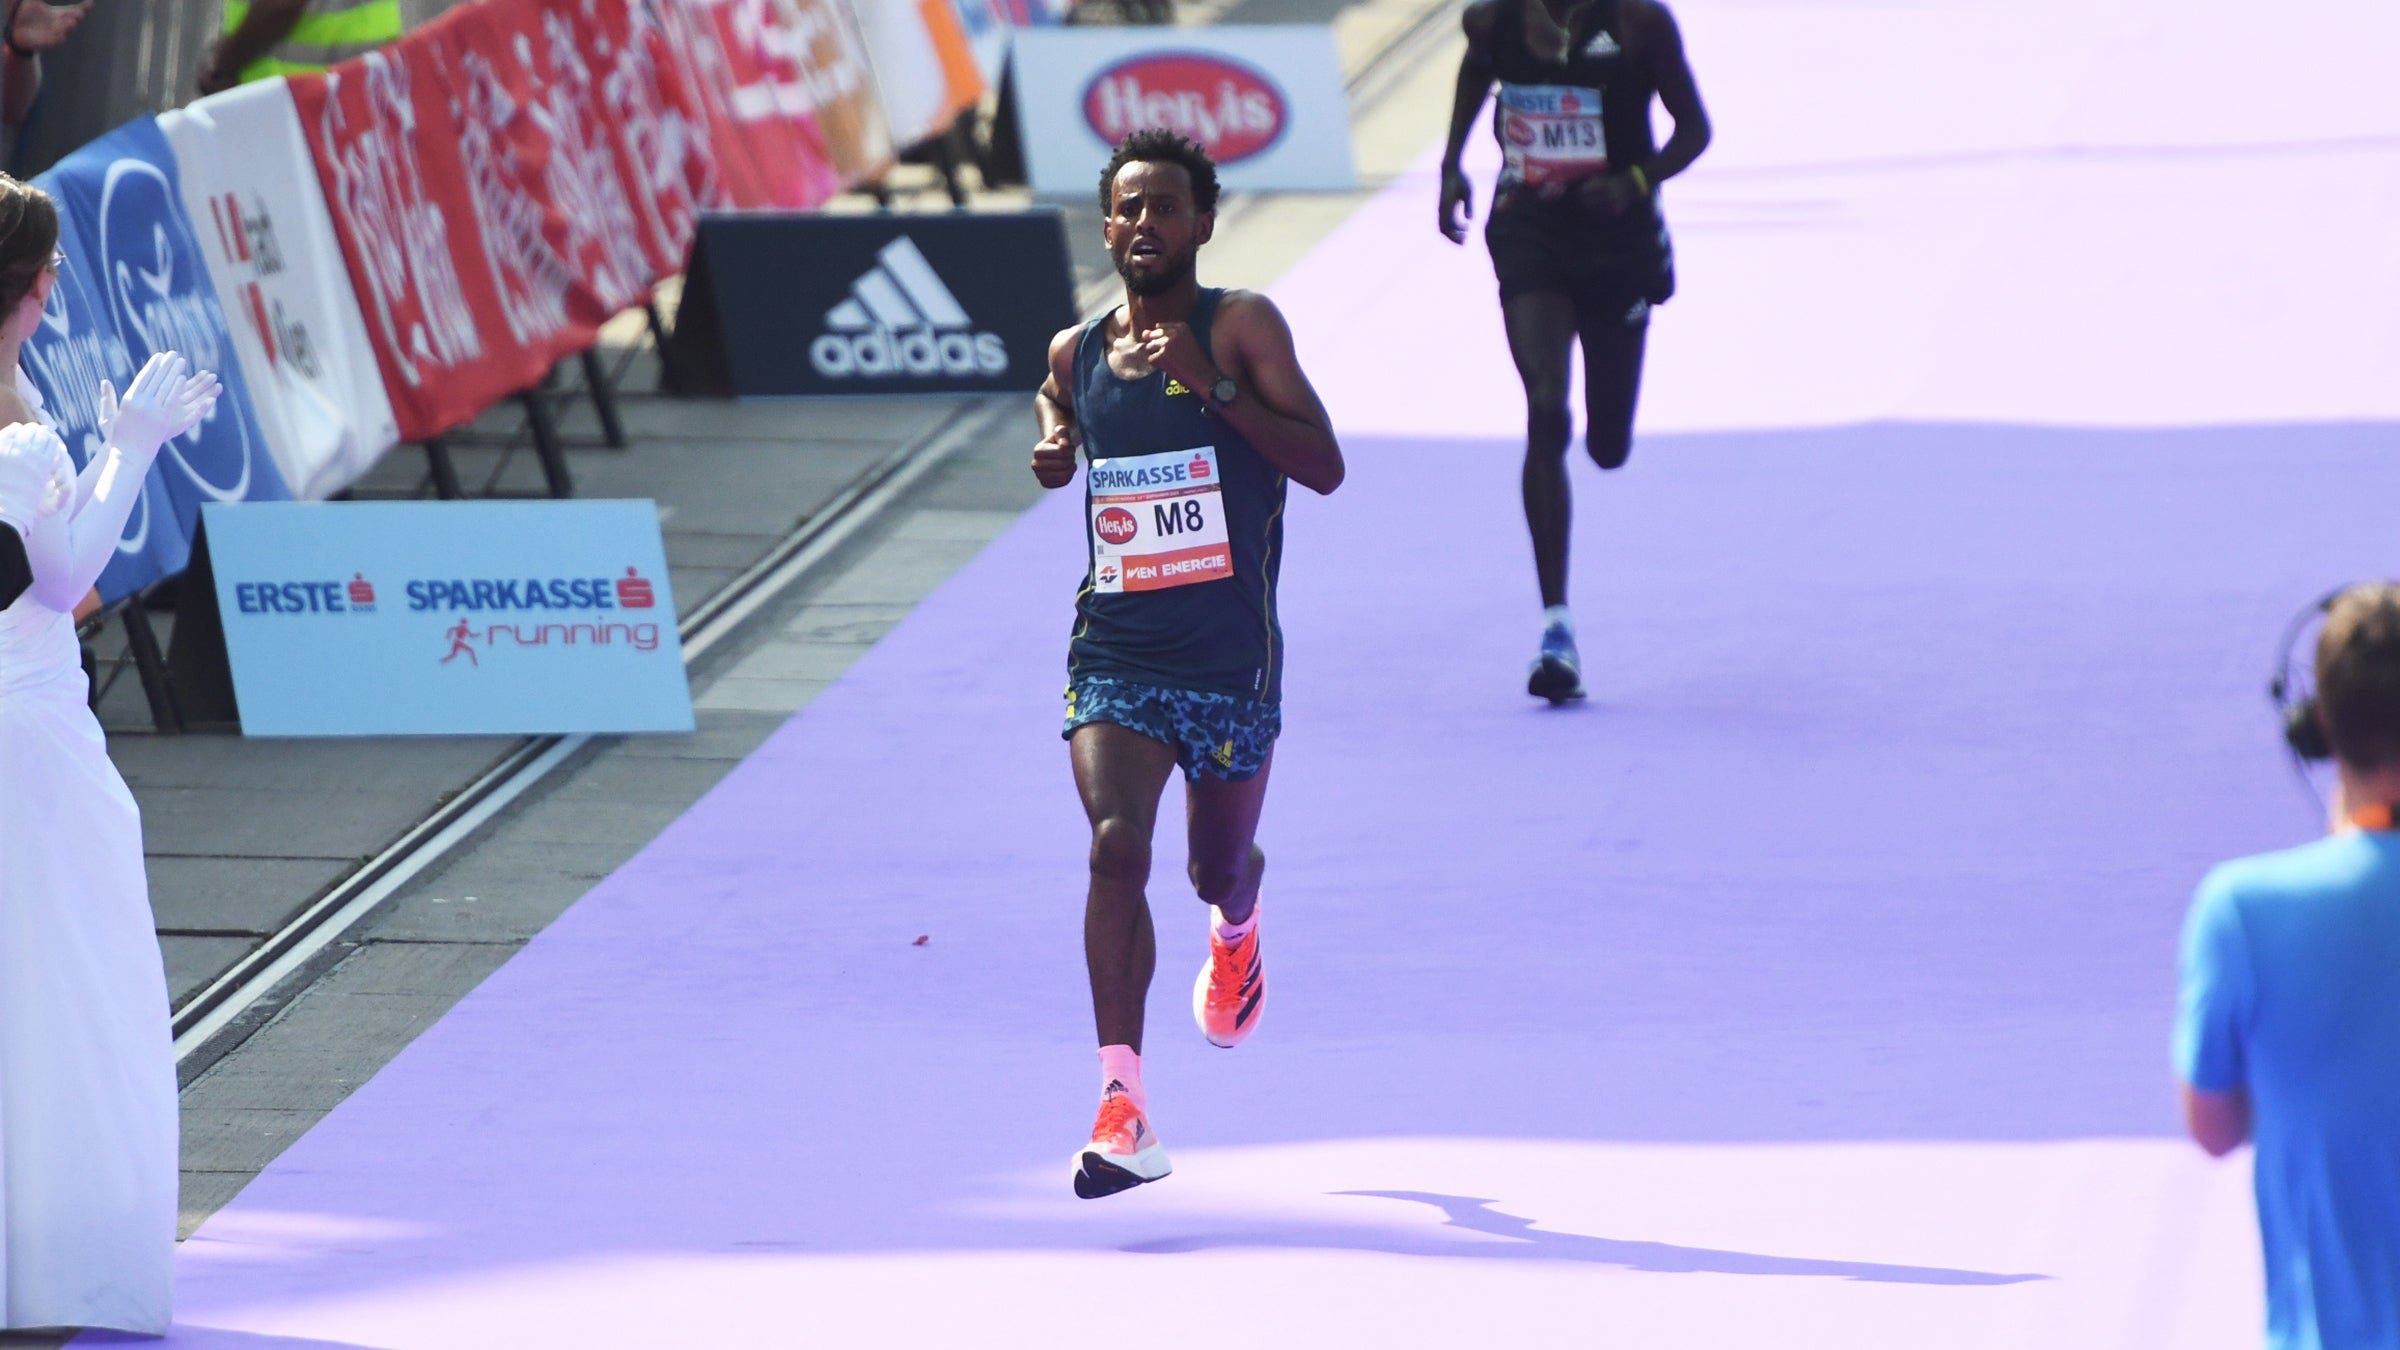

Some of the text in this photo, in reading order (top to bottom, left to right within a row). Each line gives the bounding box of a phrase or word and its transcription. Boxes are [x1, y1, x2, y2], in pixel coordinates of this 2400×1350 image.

[1543, 121, 1596, 148] M13
[810, 332, 1007, 379] adidas
[1093, 464, 1186, 488] SPARKASSE
[1099, 516, 1135, 536] Hervis
[1154, 499, 1204, 537] M8
[1126, 554, 1226, 579] WIEN ENERGIE
[236, 582, 345, 613] ERSTE
[406, 578, 614, 610] SPARKASSE
[488, 616, 660, 650] running
